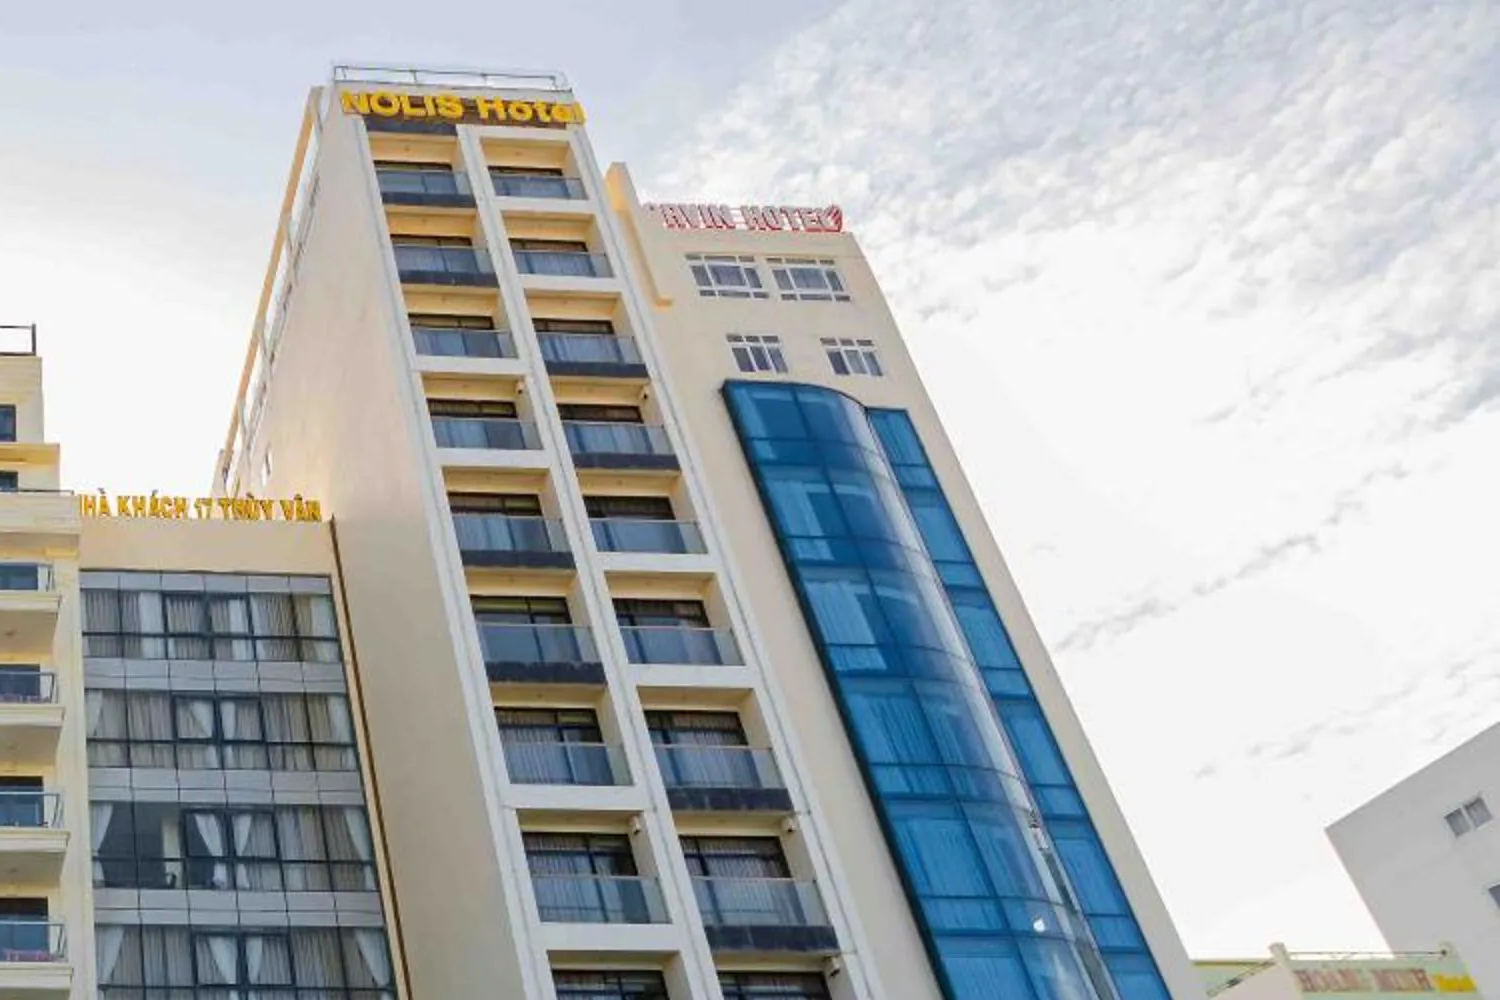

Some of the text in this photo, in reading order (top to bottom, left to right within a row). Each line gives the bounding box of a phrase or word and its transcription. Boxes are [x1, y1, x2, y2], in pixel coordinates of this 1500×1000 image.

[341, 90, 588, 125] NOLIS Hotel
[739, 205, 841, 232] HOTEL
